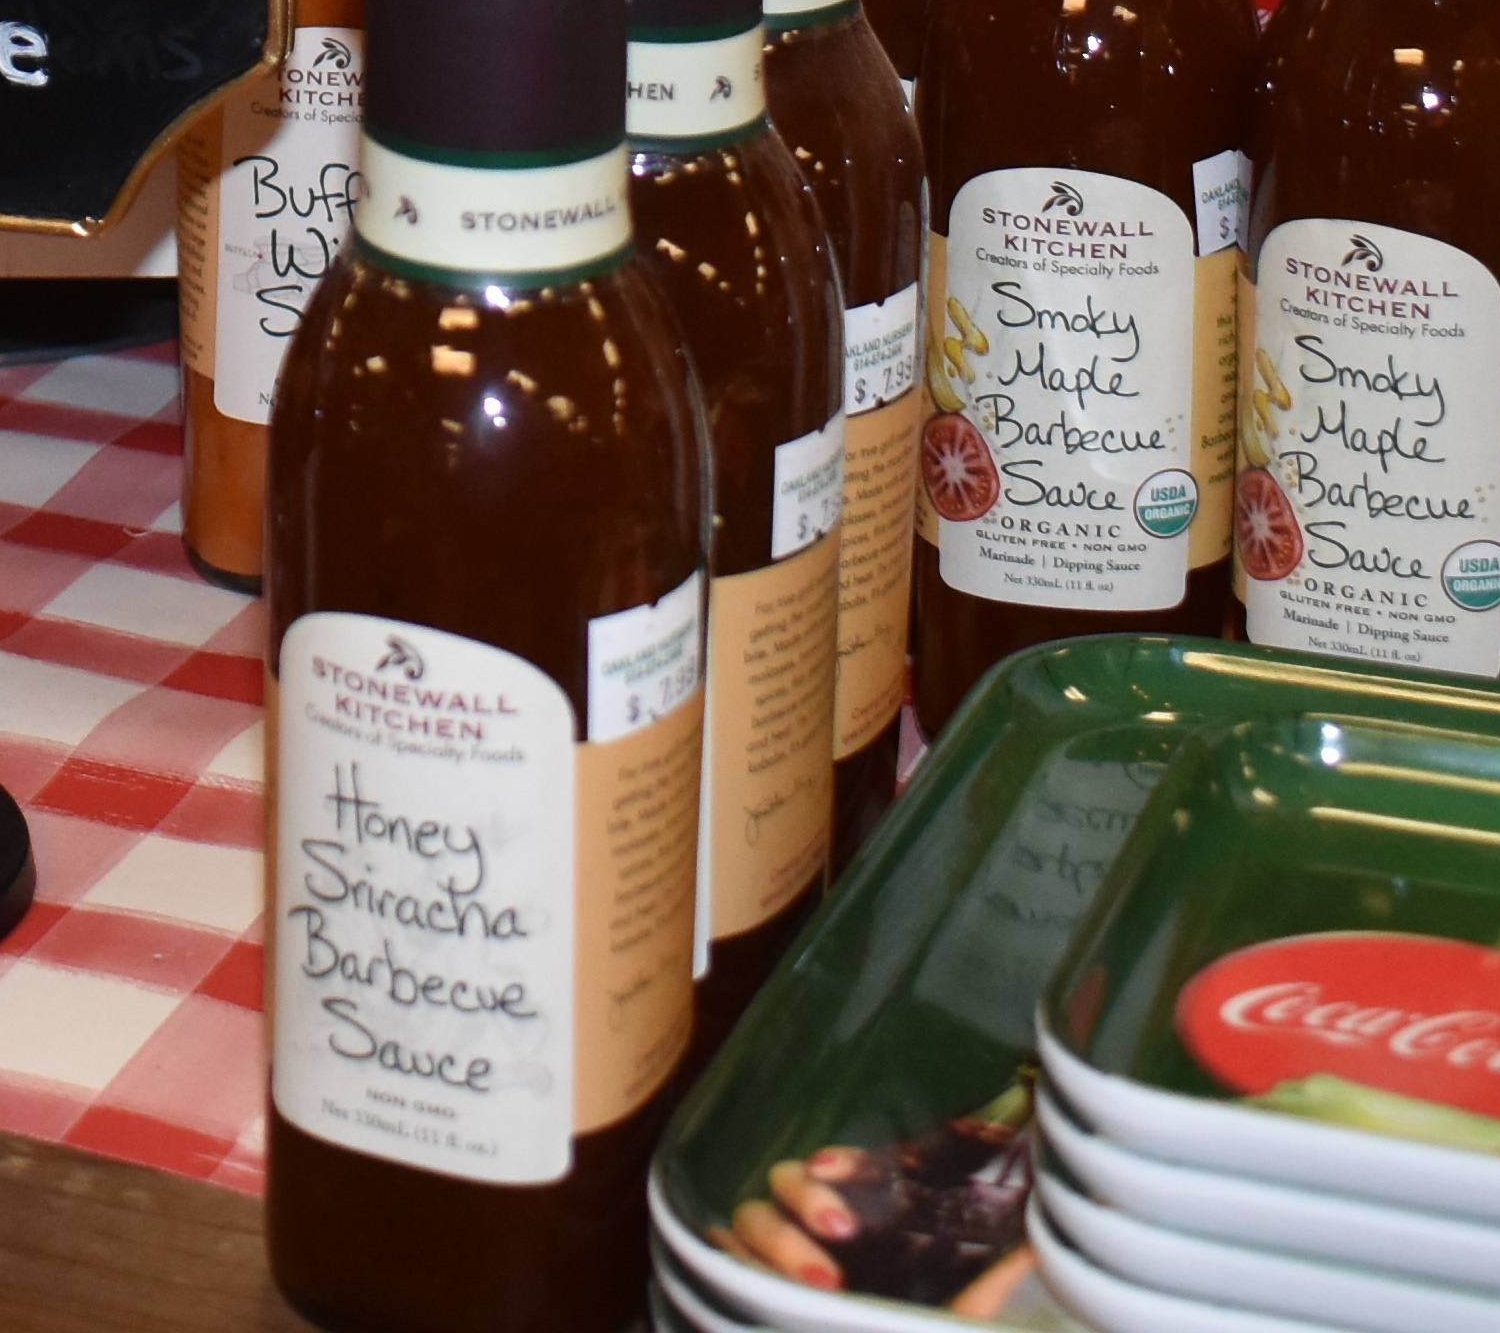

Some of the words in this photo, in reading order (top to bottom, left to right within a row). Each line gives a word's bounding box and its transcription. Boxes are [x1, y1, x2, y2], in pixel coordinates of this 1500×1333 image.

[460, 196, 617, 232] STONEWALL
[982, 207, 1154, 237] STONEWALL
[976, 248, 1029, 272] Creators
[1035, 259, 1047, 274] of
[1051, 261, 1114, 279] Specialty
[1119, 262, 1159, 276] Foods
[1004, 234, 1128, 260] KITCHEN
[1286, 258, 1458, 298] STONEWALL
[992, 281, 1140, 363] Smoky
[1280, 298, 1328, 323] Creators
[1333, 314, 1348, 329] of
[1352, 317, 1415, 339] Specialty
[1421, 323, 1465, 338] Foods
[1306, 286, 1430, 319] KITCHEN
[998, 342, 1140, 410] Maple
[1295, 334, 1446, 427] Smoky
[975, 394, 1166, 454] Barbecue
[1300, 399, 1446, 473] Maple
[1001, 460, 1125, 512] Sauce
[1150, 484, 1187, 502] USDA
[1279, 450, 1475, 520] Barbecue
[1001, 516, 1122, 539] ORGANIC
[1145, 503, 1190, 521] ORGANIC
[976, 529, 1026, 546] GLUTEN
[1031, 539, 1066, 551] FREE
[1083, 542, 1112, 553] NON
[1117, 542, 1147, 553] GMO
[979, 545, 1035, 567] Marinade
[1053, 554, 1103, 573] Dipping
[1106, 559, 1140, 572] Sauce
[1305, 521, 1431, 581] Sauce
[1459, 557, 1499, 574] USDA
[1305, 577, 1428, 608] ORGANIC
[312, 655, 518, 715] STONEWALL
[335, 694, 483, 741] KITCHEN
[325, 761, 484, 895] Honey
[301, 837, 528, 939] Sriracha
[288, 906, 538, 1019] Barbecue
[321, 995, 491, 1093] Sauce
